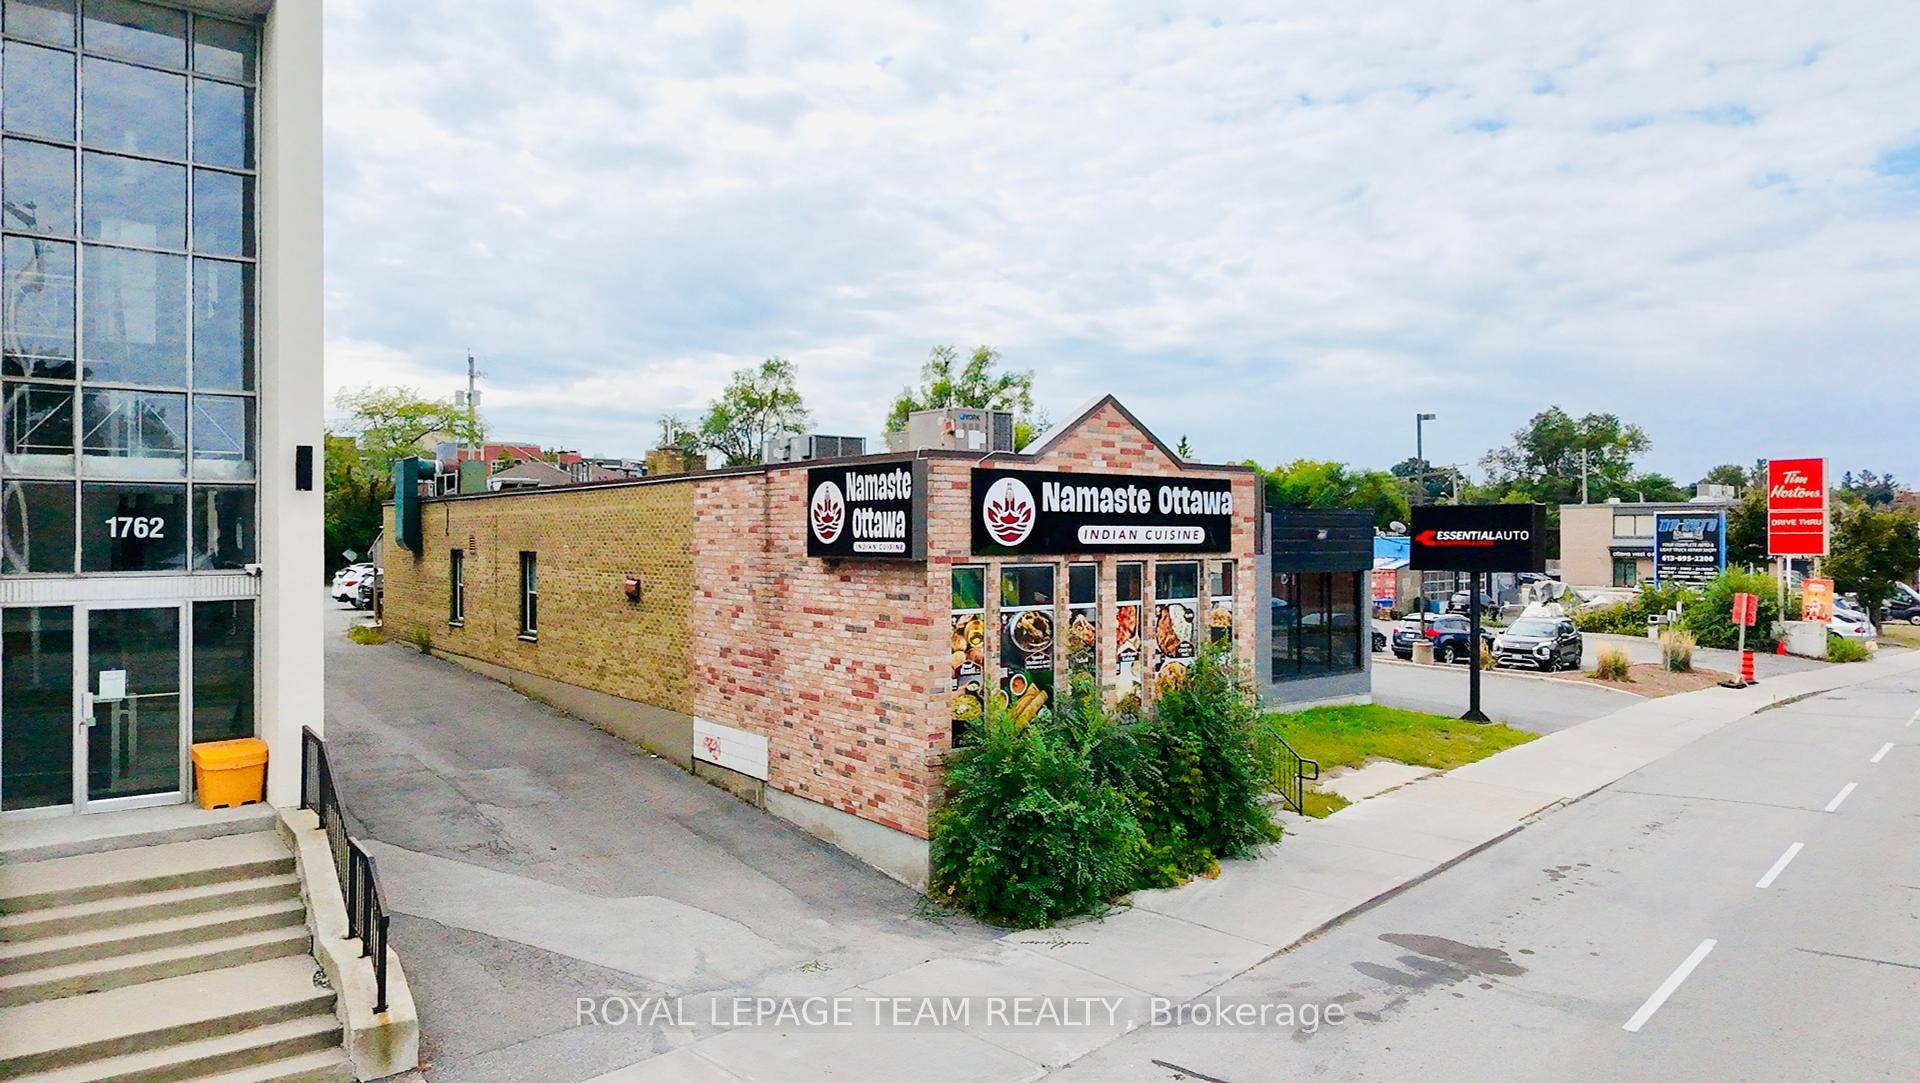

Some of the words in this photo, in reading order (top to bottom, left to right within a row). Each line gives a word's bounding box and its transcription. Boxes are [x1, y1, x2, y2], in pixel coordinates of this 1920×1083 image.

[1783, 470, 1808, 484] Tim
[845, 467, 912, 502] Namaste
[1770, 484, 1820, 498] Hortons
[1041, 481, 1151, 514] Namaste
[1158, 485, 1233, 515] Ottawa
[104, 516, 165, 539] 1762
[852, 507, 906, 539] Ottawa
[1771, 518, 1797, 526] DRIVE
[1799, 518, 1822, 526] THRU
[1083, 529, 1138, 540] INDIAN
[1145, 529, 1200, 540] CUISINE
[1436, 530, 1530, 541] ESSENTIALAUTO
